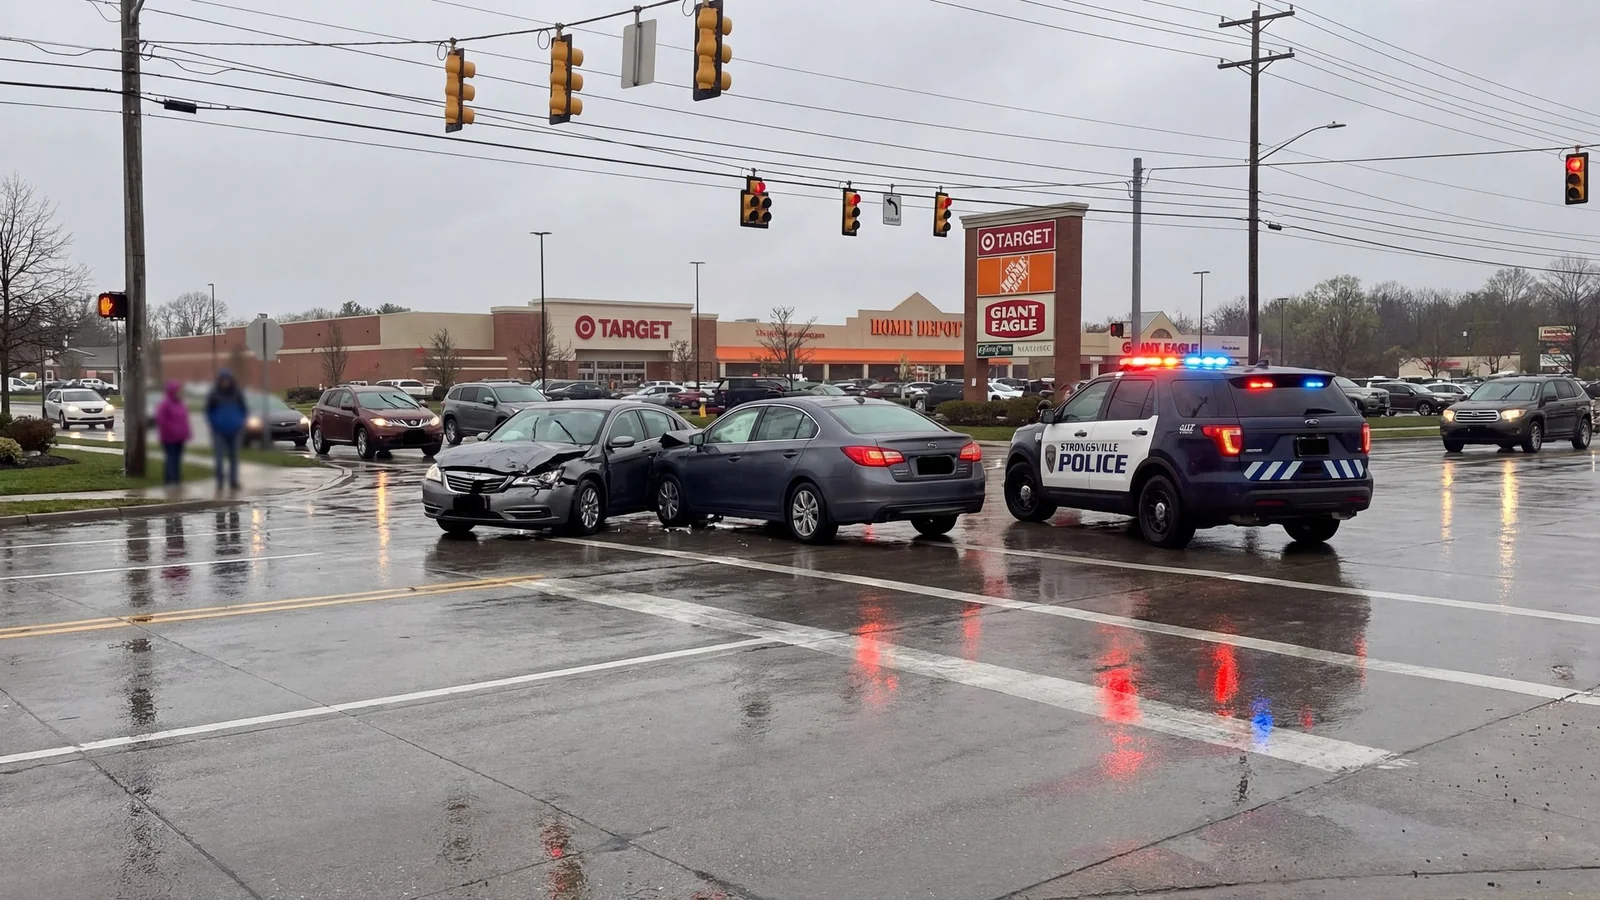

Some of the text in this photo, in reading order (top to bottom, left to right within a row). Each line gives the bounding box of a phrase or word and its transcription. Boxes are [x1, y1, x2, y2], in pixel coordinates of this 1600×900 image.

[996, 228, 1052, 248] TARGET
[1001, 256, 1028, 293] HOME
[990, 305, 1039, 319] GIANT
[598, 318, 672, 339] TARGET
[870, 318, 963, 337] HOME DEPOT
[991, 319, 1037, 332] EAGLE
[1122, 341, 1199, 354] GANT EAGLE
[1060, 443, 1119, 452] STRONGSVILLE
[1058, 453, 1128, 474] POLICE
